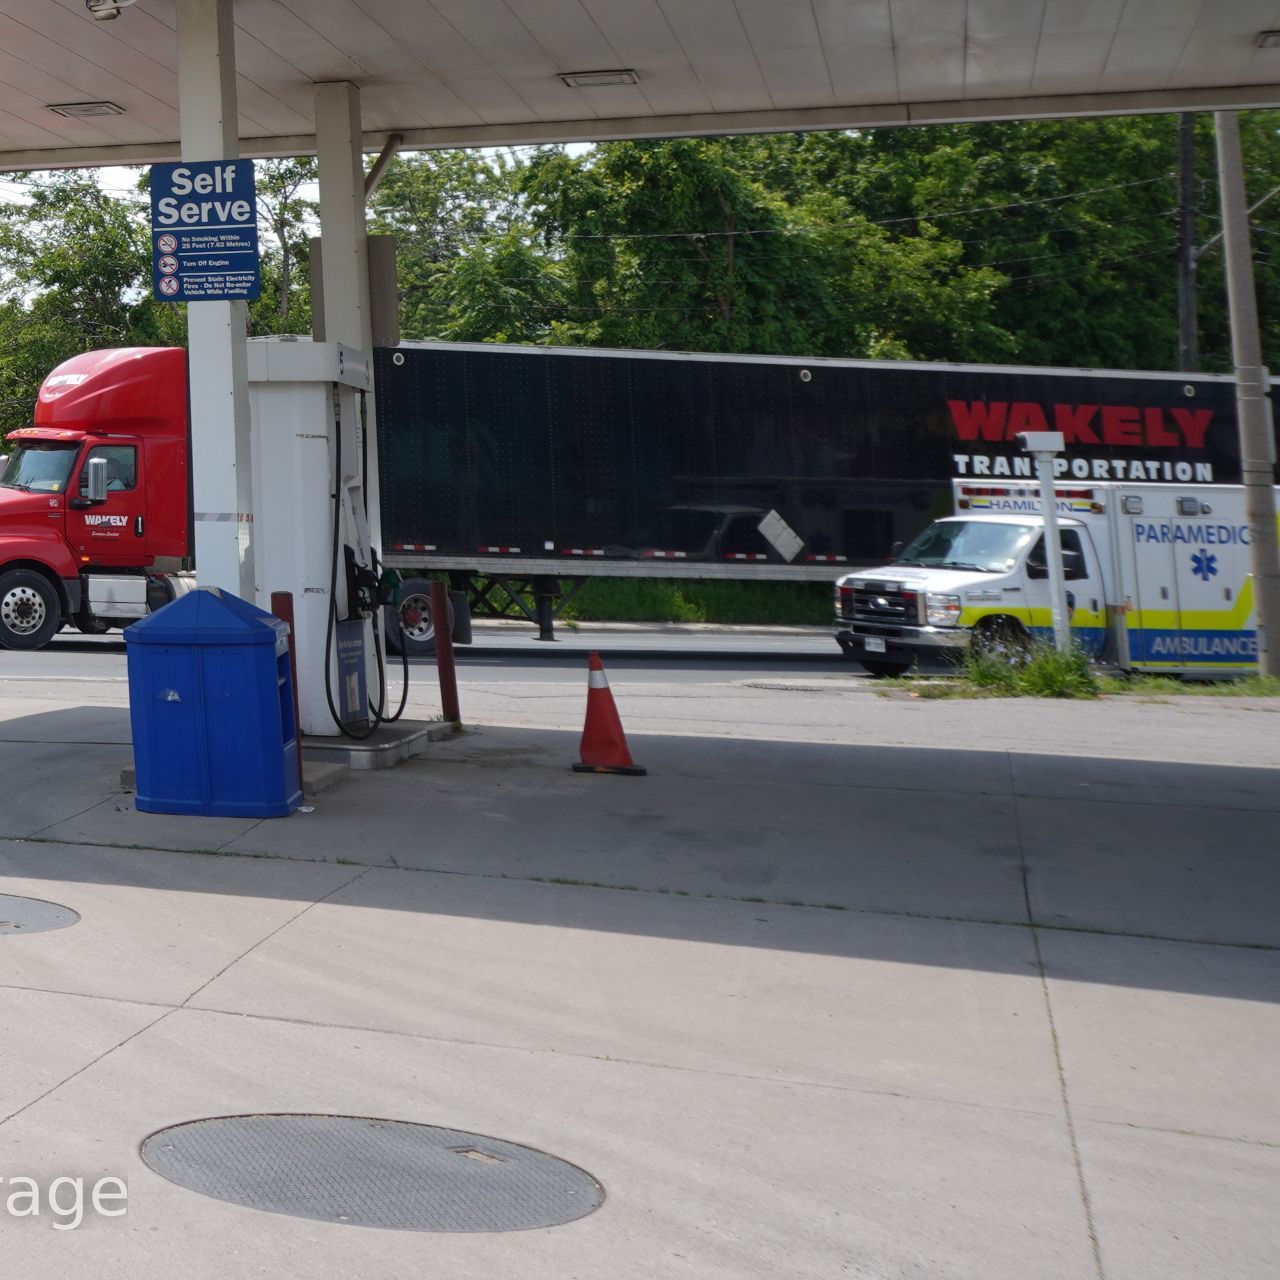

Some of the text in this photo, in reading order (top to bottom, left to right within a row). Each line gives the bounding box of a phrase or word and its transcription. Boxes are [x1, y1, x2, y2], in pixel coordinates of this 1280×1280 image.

[171, 165, 236, 196] Self
[157, 197, 251, 224] Serve
[947, 399, 1215, 448] WAKELY
[990, 500, 1073, 512] HAMILN
[84, 514, 129, 526] WAKELY
[1135, 524, 1250, 545] PARAMEDIC
[1151, 637, 1258, 656] AMBULANCE
